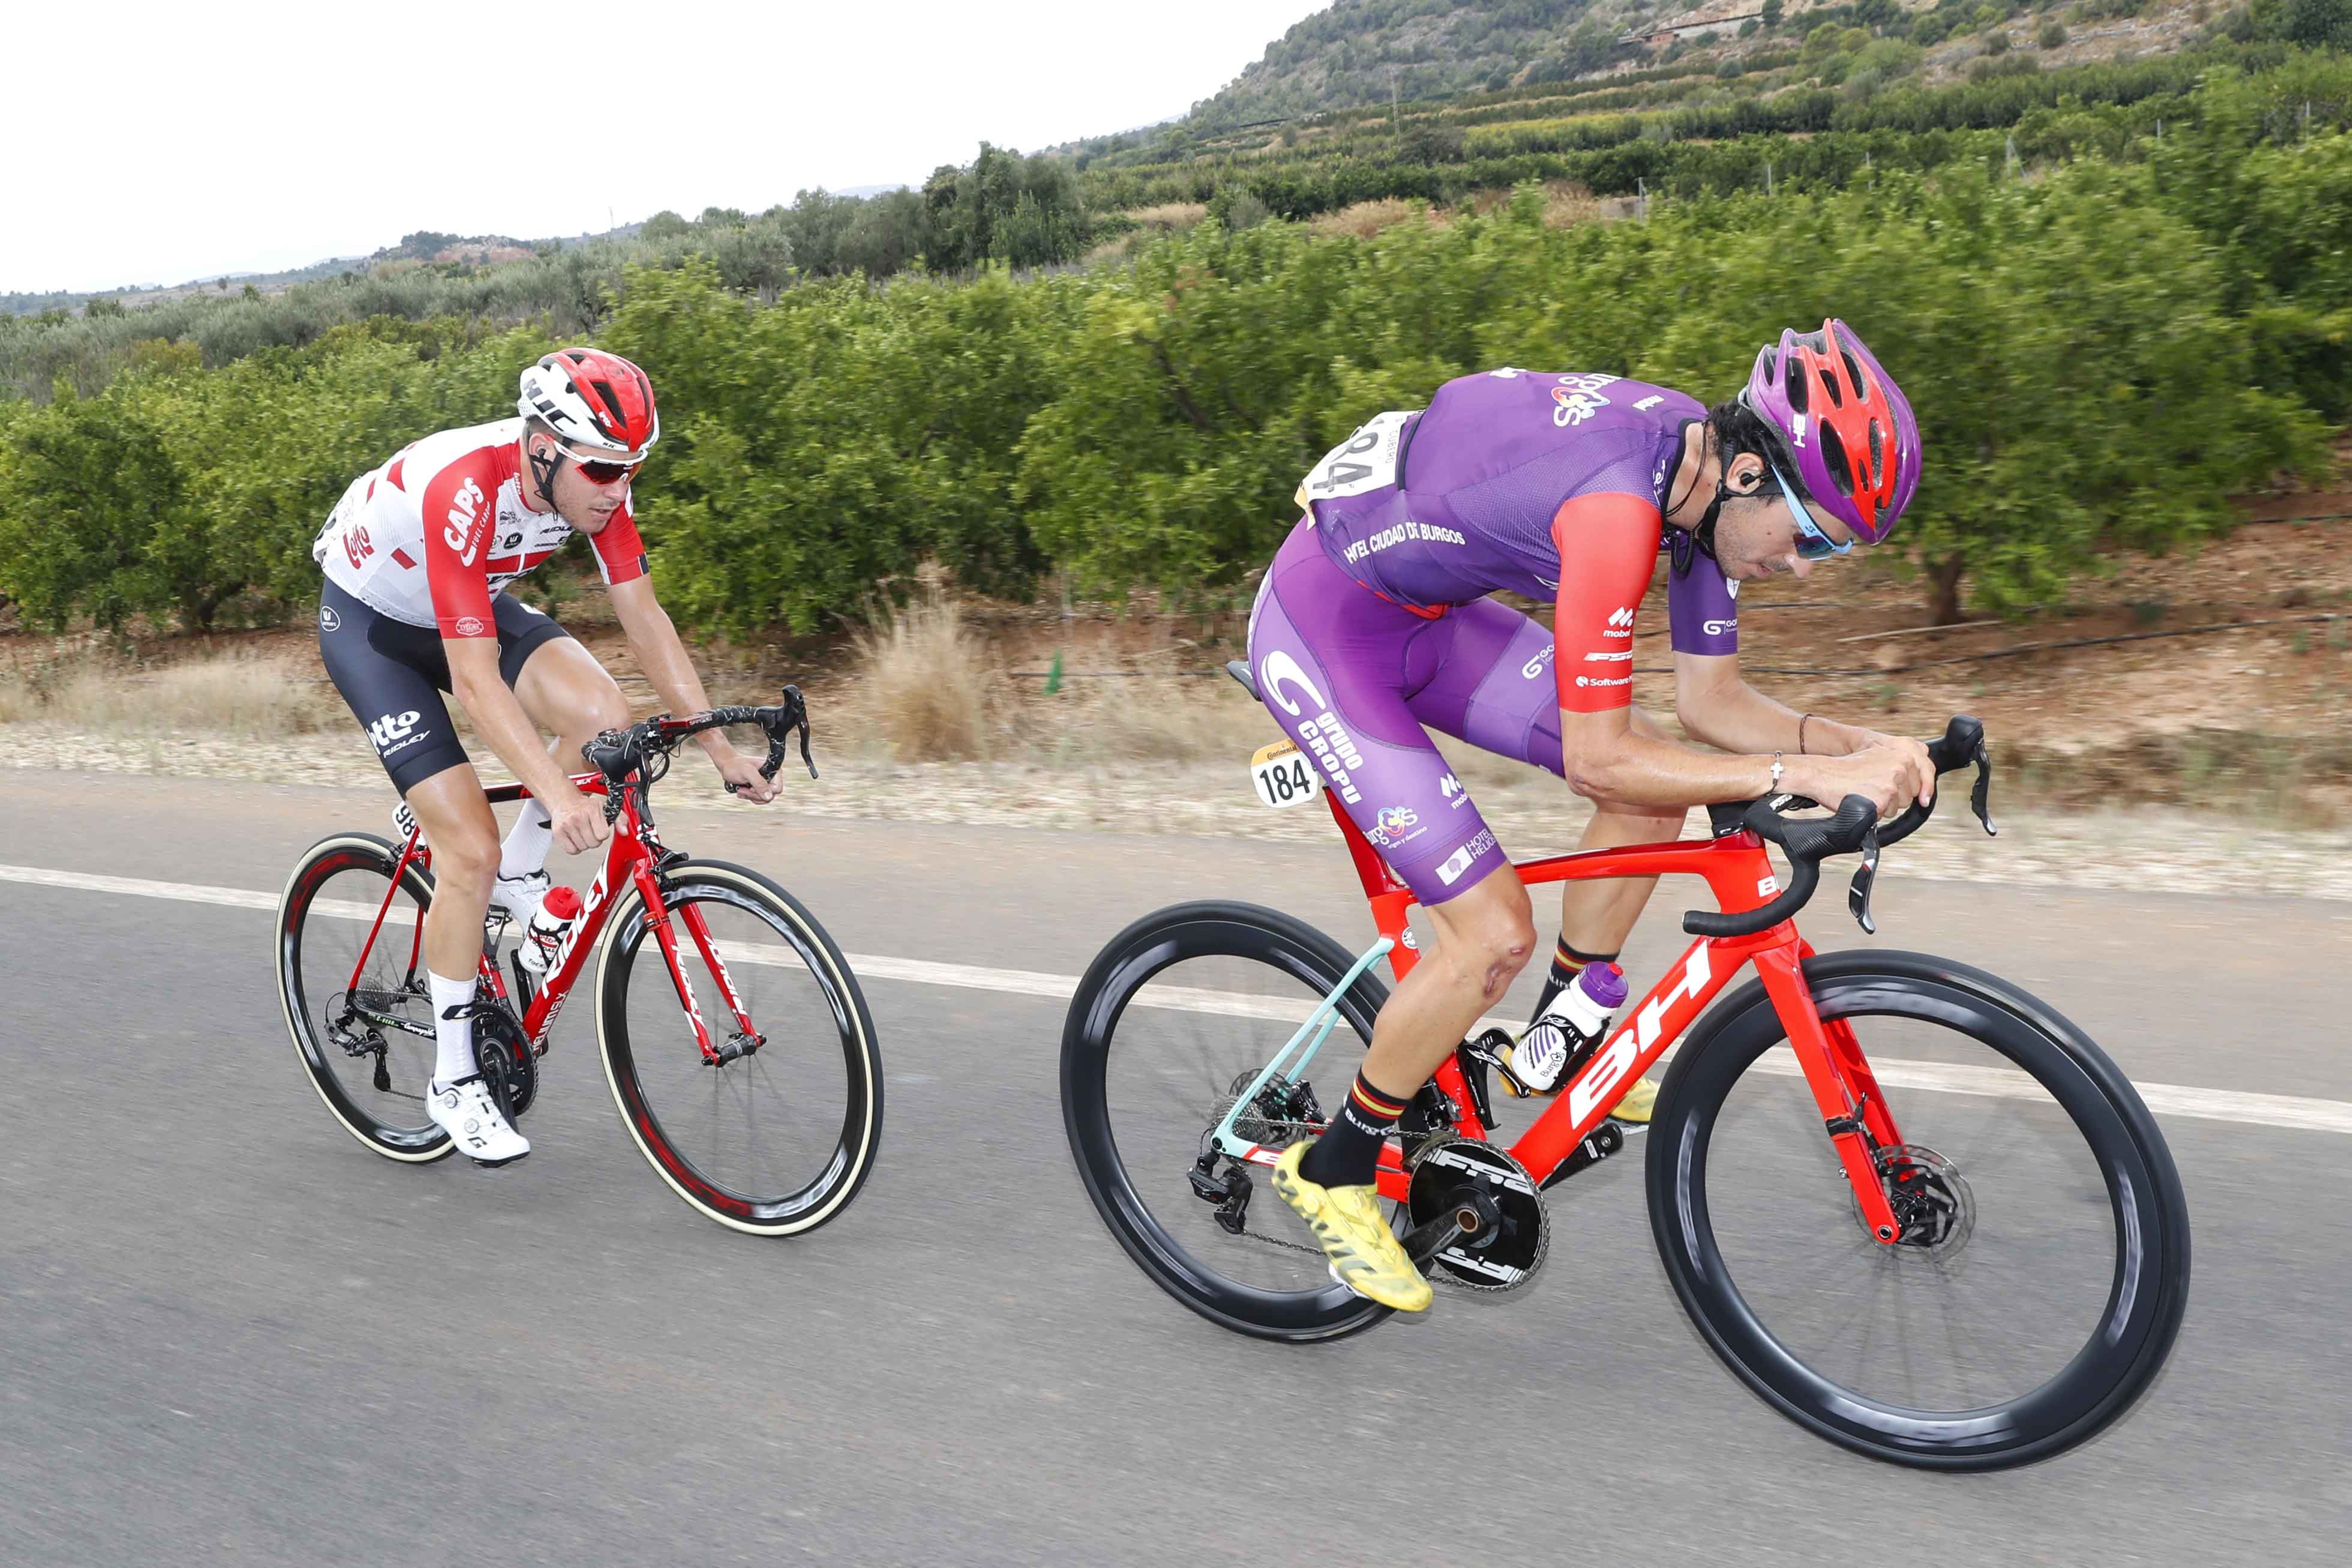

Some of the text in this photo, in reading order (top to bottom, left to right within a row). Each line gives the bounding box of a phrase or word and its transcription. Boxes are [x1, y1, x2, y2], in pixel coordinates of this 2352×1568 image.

[523, 378, 577, 432] HJC
[444, 477, 484, 551] CAPS
[472, 527, 483, 548] FUEL
[1369, 524, 1406, 552] CIUDAD
[1420, 523, 1466, 545] BURGOS
[1603, 629, 1631, 638] mobel
[383, 729, 431, 759] RIDLEY
[1297, 720, 1363, 805] CROPU
[1315, 711, 1364, 771] grupo
[1260, 759, 1310, 804] 184
[1466, 828, 1490, 851] HOTEL
[541, 847, 609, 999] RIDLEY
[1569, 939, 1712, 1130] BH
